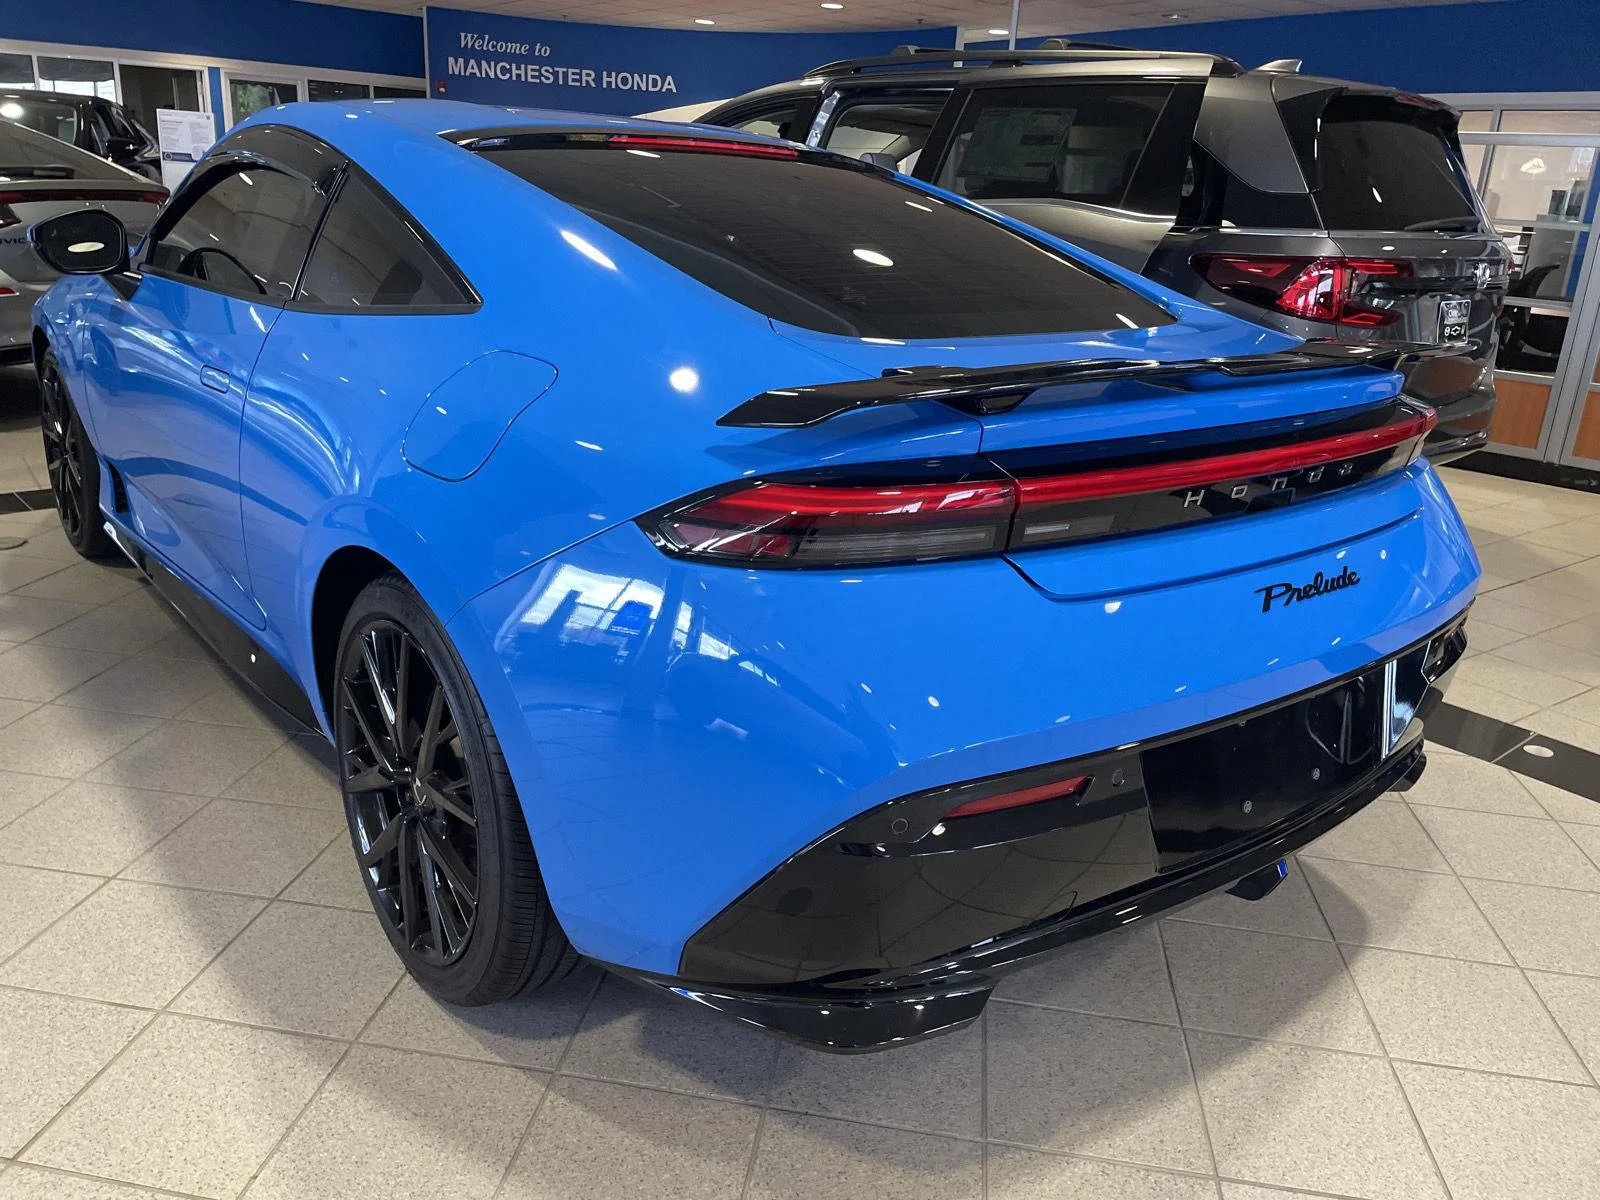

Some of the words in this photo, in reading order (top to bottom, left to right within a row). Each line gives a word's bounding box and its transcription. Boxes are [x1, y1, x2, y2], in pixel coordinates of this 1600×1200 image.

[460, 32, 529, 55] Welcome
[534, 42, 551, 57] to
[448, 56, 596, 88] MANCHESTER
[602, 71, 678, 93] HONDA
[1254, 565, 1361, 613] Prelude
